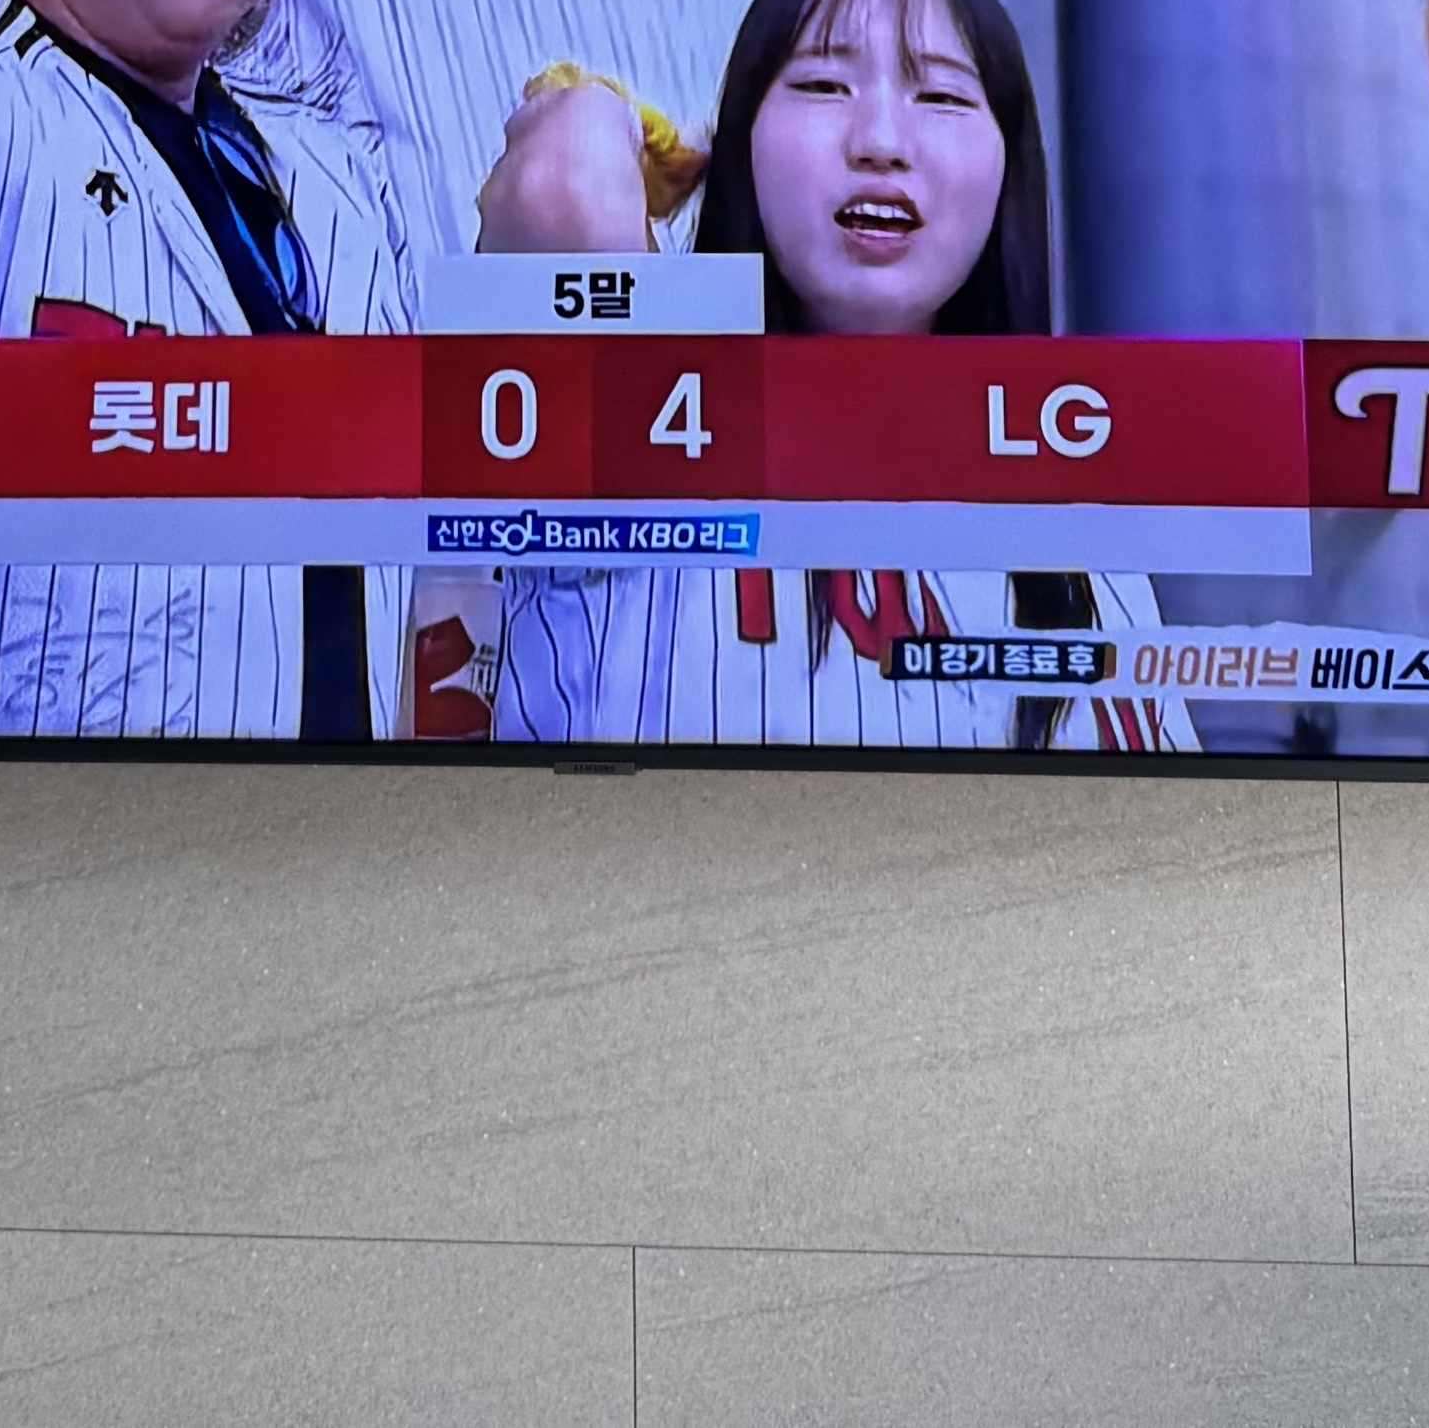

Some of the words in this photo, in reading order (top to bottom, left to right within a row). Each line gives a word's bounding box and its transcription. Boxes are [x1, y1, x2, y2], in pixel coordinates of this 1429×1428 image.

[553, 271, 636, 320] 5말
[89, 380, 231, 454] 롯데
[480, 368, 538, 460] 0
[649, 372, 713, 459] 4
[987, 384, 1113, 458] LG
[904, 642, 932, 675] 이
[939, 643, 996, 676] 경기
[1003, 644, 1060, 676] 종료
[1067, 644, 1095, 676] 후
[1132, 645, 1298, 689] 아이러브
